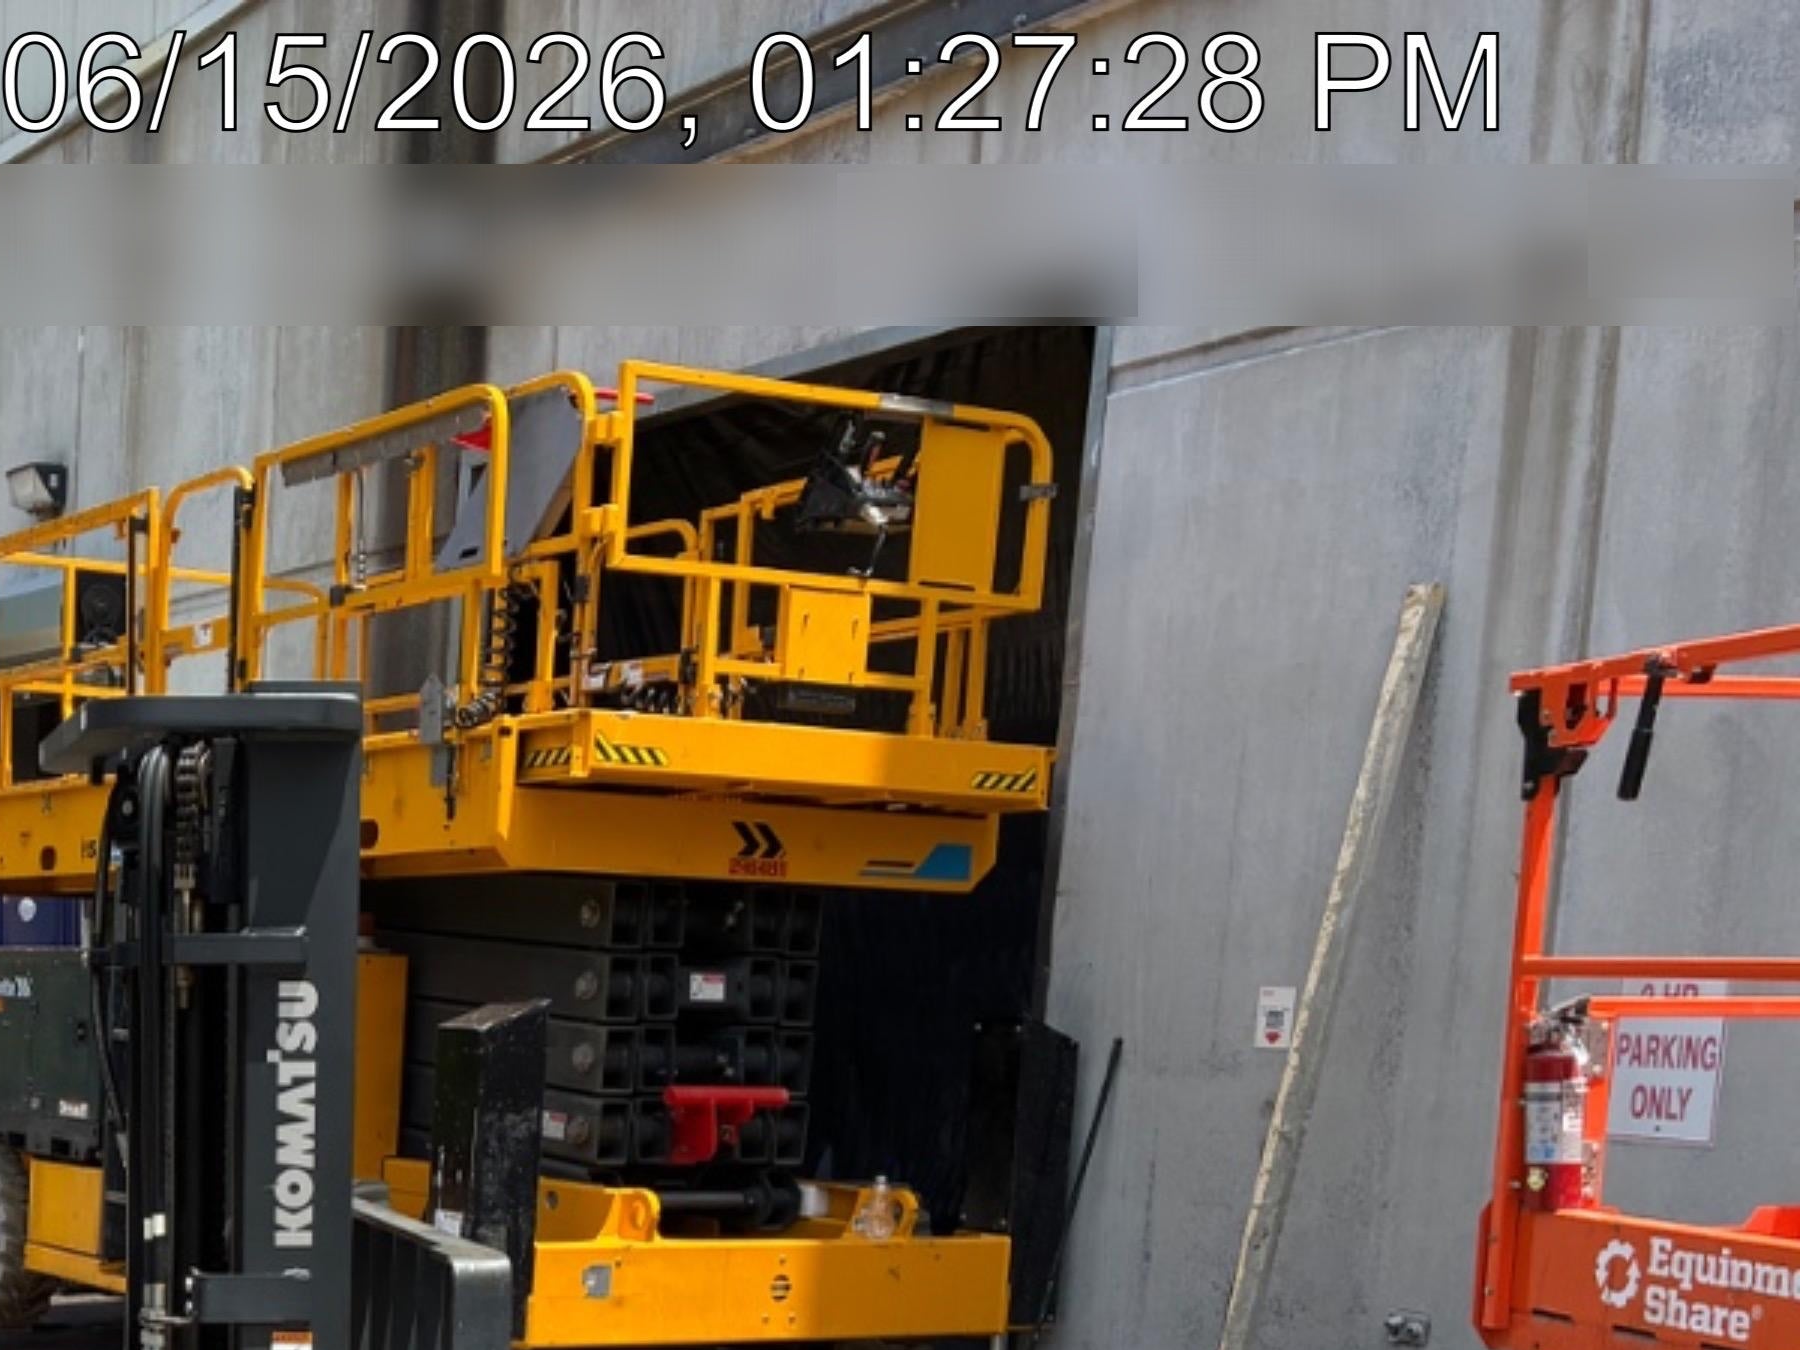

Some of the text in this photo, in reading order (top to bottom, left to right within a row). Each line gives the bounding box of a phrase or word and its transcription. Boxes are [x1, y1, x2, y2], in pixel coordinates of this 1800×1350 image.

[1616, 1032, 1718, 1071] PARKING
[268, 979, 319, 1247] KOMATSU
[1631, 1083, 1694, 1122] ONLY
